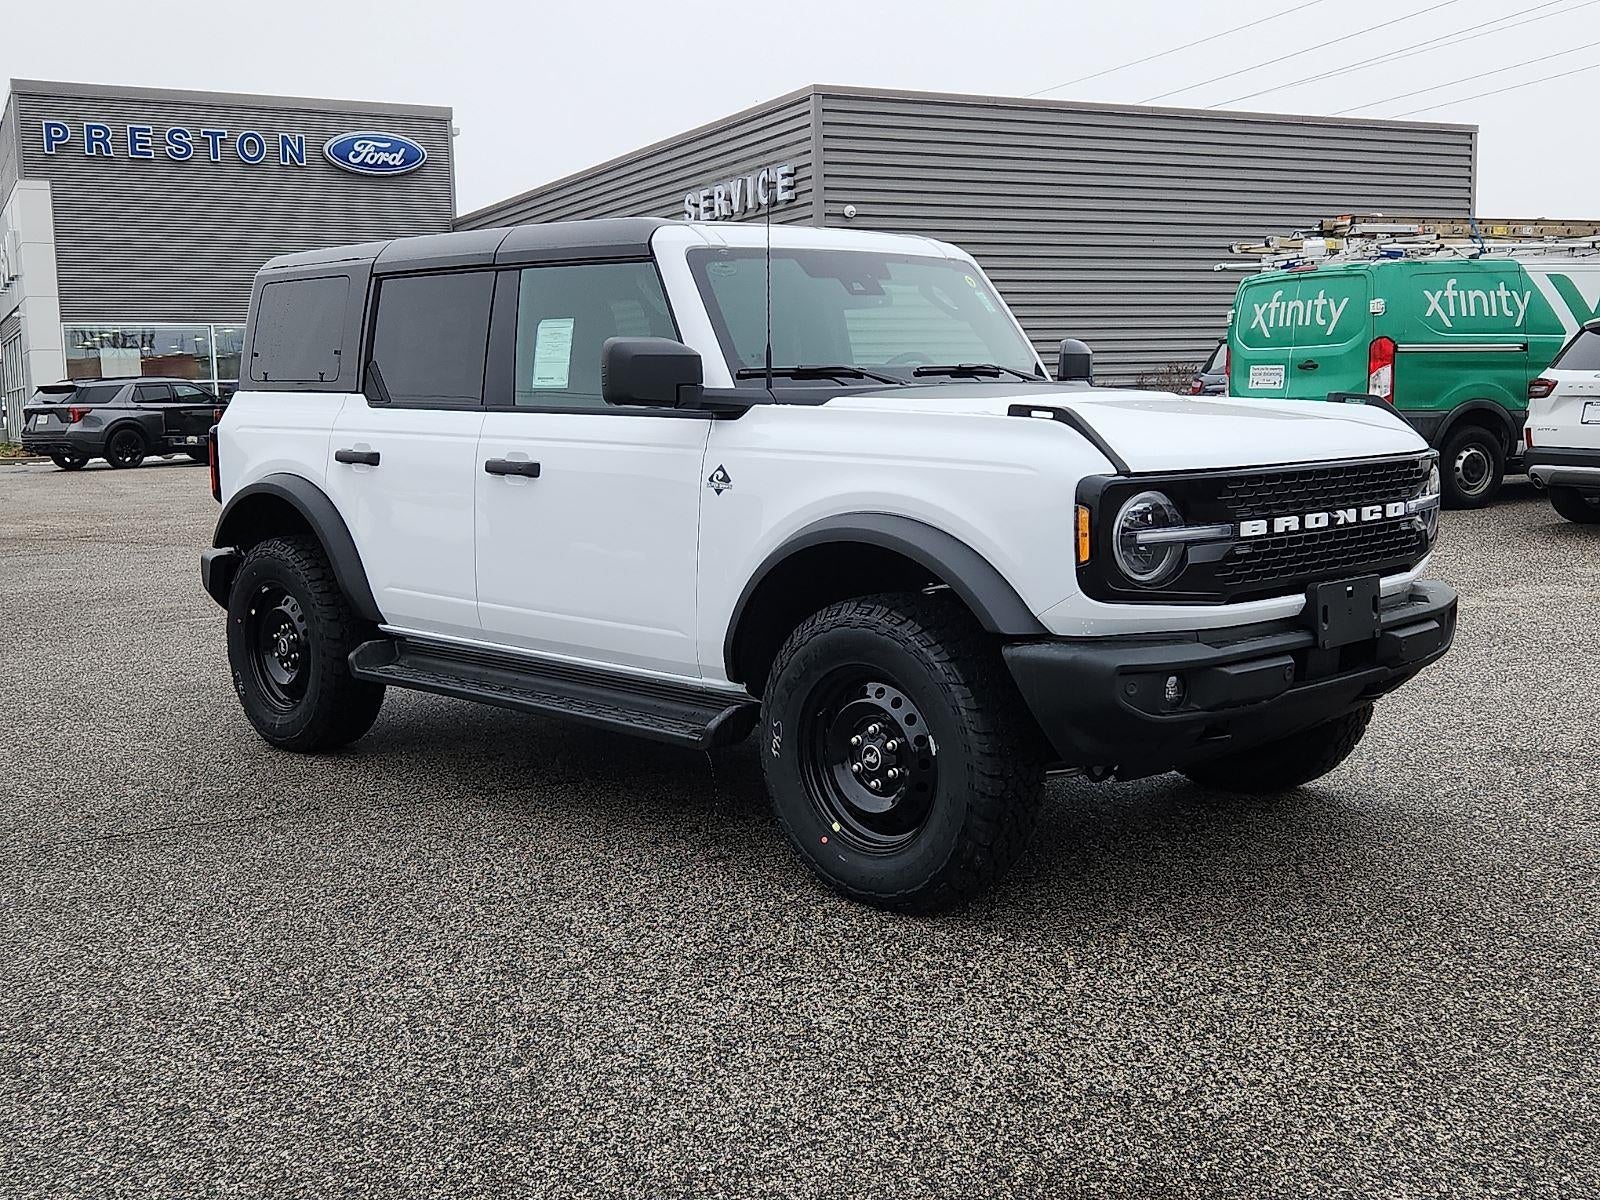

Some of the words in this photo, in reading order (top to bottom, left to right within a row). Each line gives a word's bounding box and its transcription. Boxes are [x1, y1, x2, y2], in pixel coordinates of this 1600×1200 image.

[42, 120, 307, 166] PRESTON
[348, 140, 405, 166] Ford
[684, 164, 796, 221] SERVICE
[1250, 289, 1350, 338] xfinity
[1423, 278, 1532, 327] xfinity
[1239, 501, 1405, 537] BRONCO
